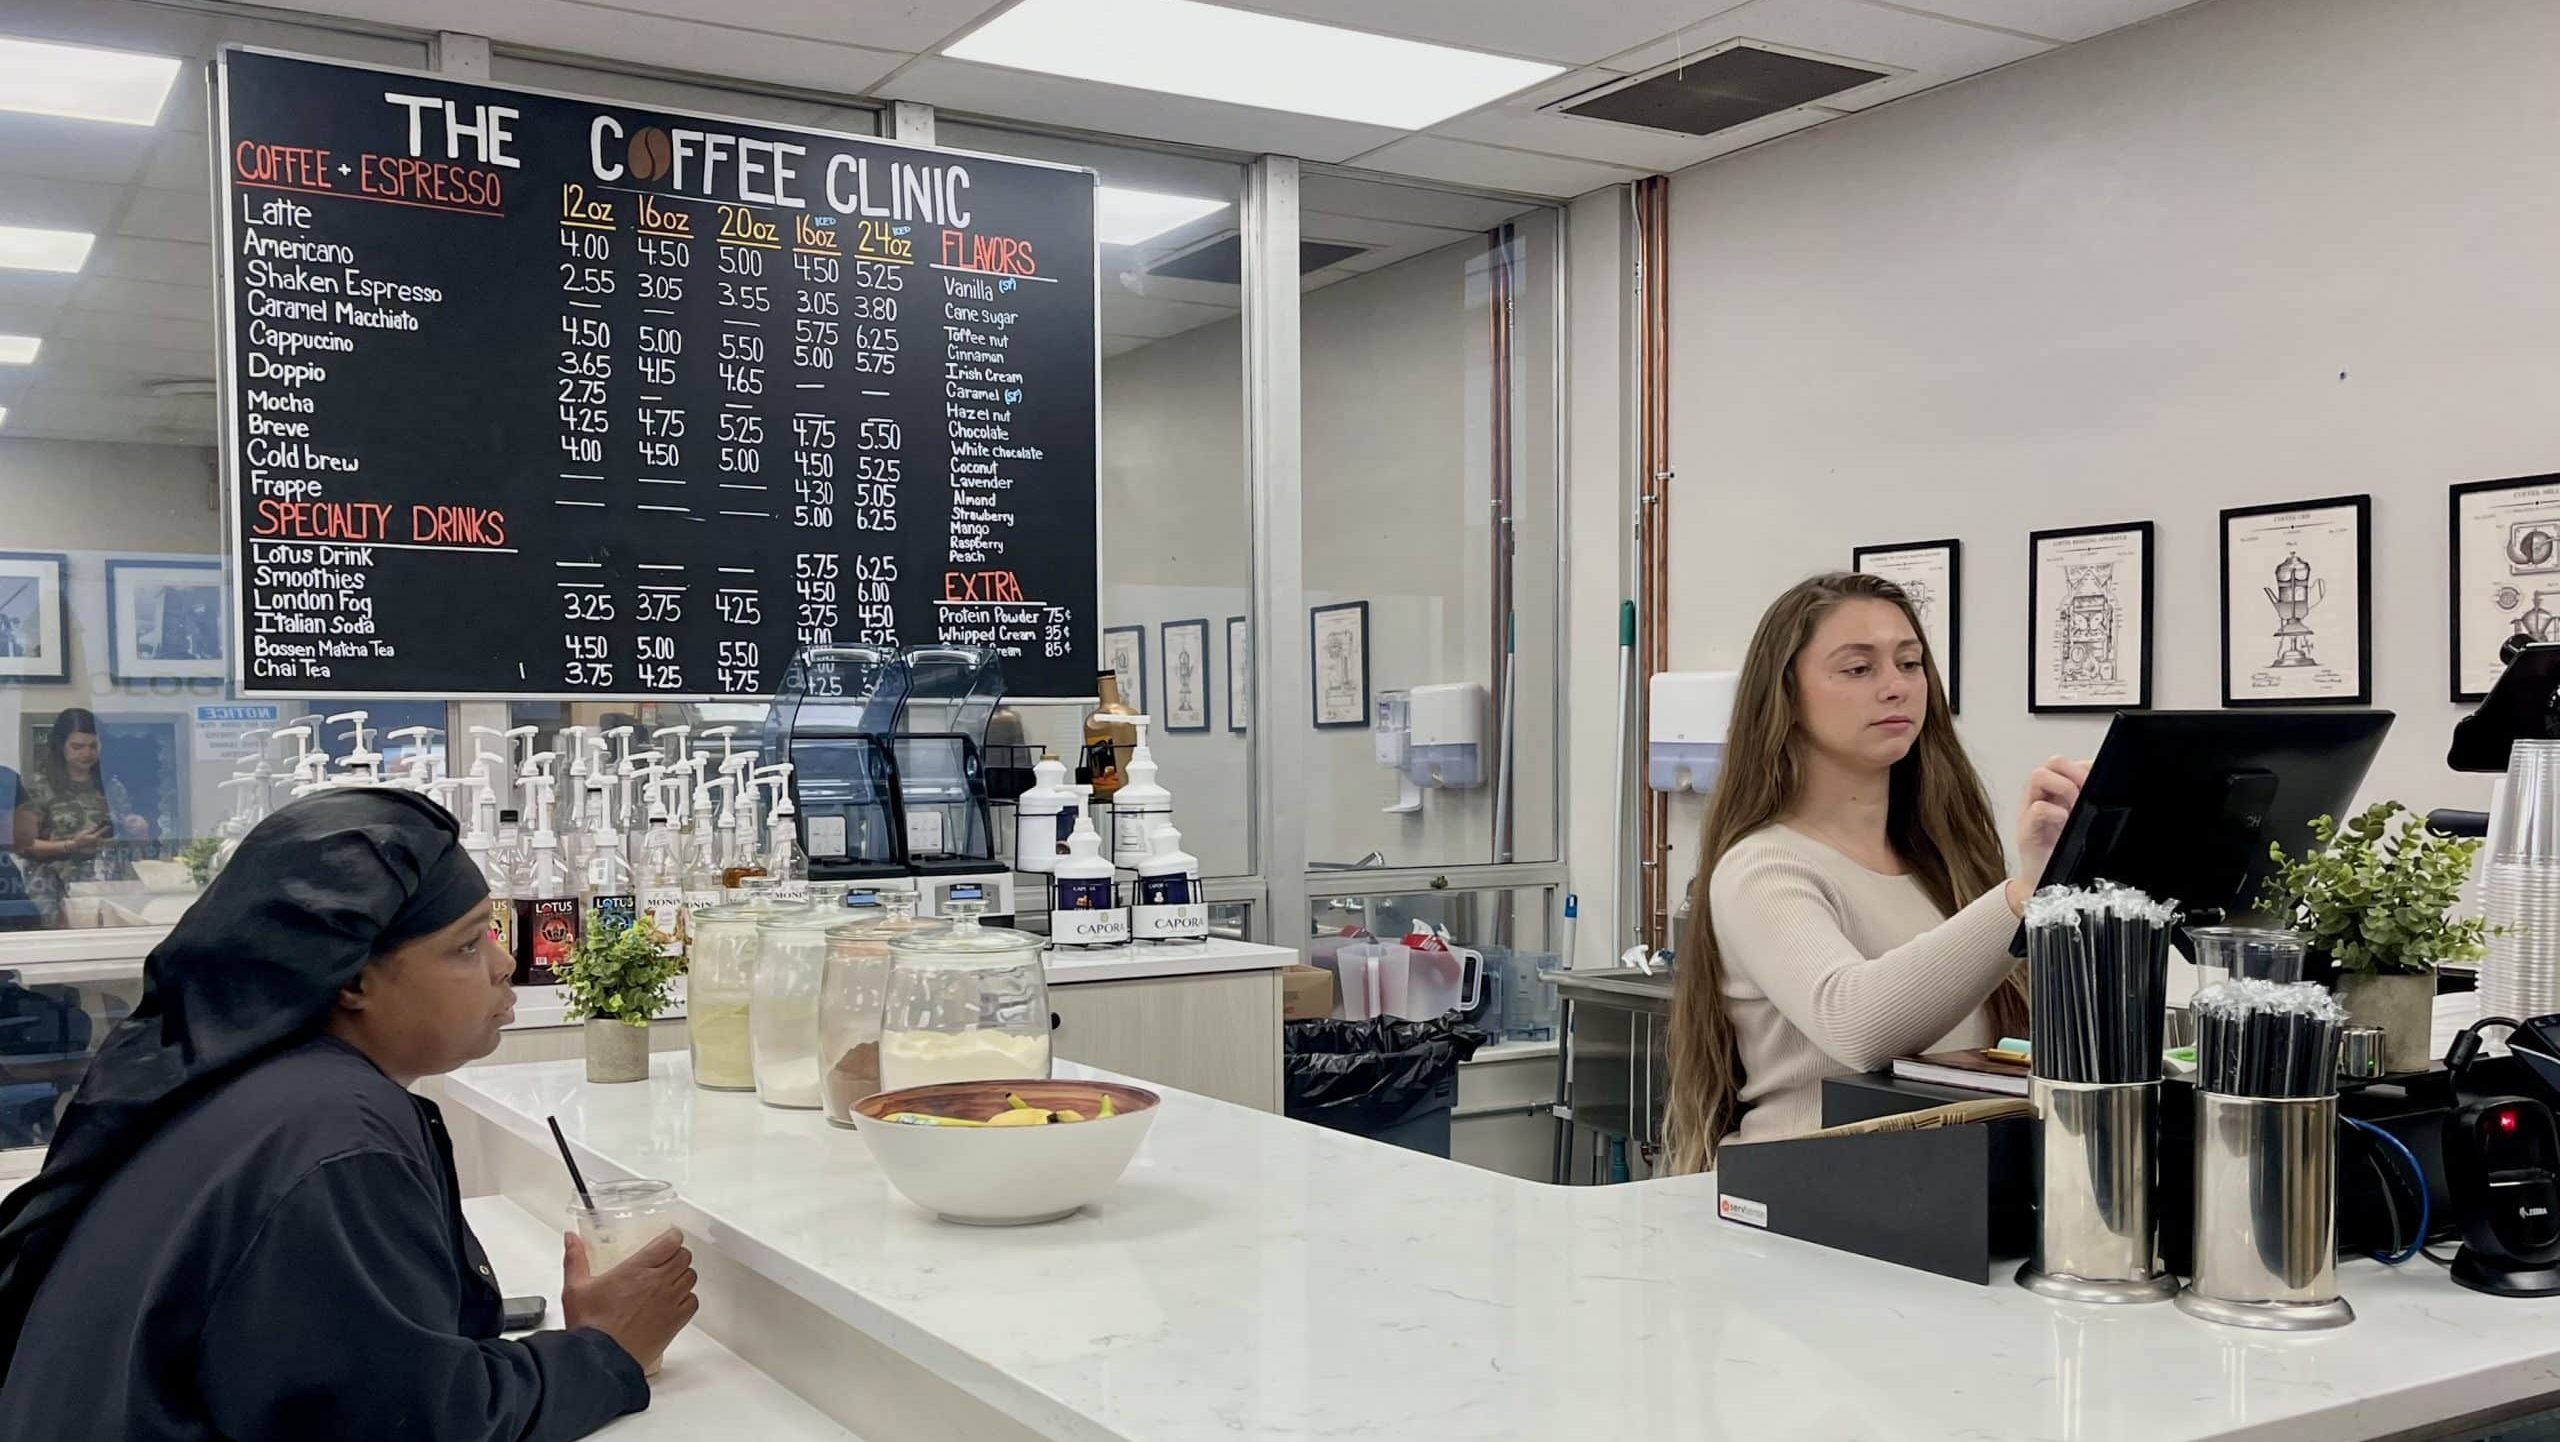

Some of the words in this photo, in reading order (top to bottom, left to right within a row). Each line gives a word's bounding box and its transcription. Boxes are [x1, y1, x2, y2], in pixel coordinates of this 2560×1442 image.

[235, 140, 332, 188] COFFEE
[361, 153, 500, 206] ESPRESSO
[385, 92, 521, 168] THE
[826, 153, 971, 228] CLINIC
[243, 194, 312, 228] Latte
[563, 183, 614, 222] 12oz
[639, 194, 690, 231] 16oz
[717, 205, 780, 241] 20oz
[795, 213, 838, 247] 16oz
[858, 220, 913, 257] 24oz
[243, 227, 353, 264] Americano
[942, 230, 1036, 275] FLAVORS
[560, 228, 610, 260] 4.00
[638, 237, 690, 267] 4.50
[718, 246, 762, 277] 5.00
[794, 253, 839, 283] 4.50
[855, 261, 904, 292] 5.25
[245, 260, 339, 293] Shaken
[345, 269, 442, 305] Espresso
[560, 263, 616, 294] 2.55
[638, 273, 684, 301] 3.05
[718, 282, 771, 312] 3.55
[796, 290, 839, 316] 3.05
[854, 296, 897, 322] 3.80
[944, 276, 993, 301] Vanilla
[247, 289, 327, 322] Caramel
[335, 300, 419, 331] Macchiato
[945, 302, 979, 322] Cane
[982, 311, 1019, 330] sugar
[249, 319, 354, 356] Cappuccino
[562, 315, 610, 348] 4.50
[638, 326, 682, 355] 5.00
[718, 334, 764, 363] 5.50
[795, 319, 839, 346] 5.75
[856, 325, 899, 351] 6.25
[944, 326, 985, 345] Toffee
[990, 335, 1009, 348] nut
[947, 344, 1004, 363] Cinnamon
[248, 352, 326, 388] Doppio
[557, 351, 612, 379] 3.65
[638, 356, 676, 385] 4.15
[719, 363, 765, 394] 4.65
[793, 345, 833, 369] 5.00
[855, 351, 896, 375] 5.75
[945, 363, 982, 381] Irish
[985, 368, 1023, 384] Cream
[248, 389, 314, 413] Mocha
[558, 379, 607, 404] 2.75
[946, 381, 999, 401] Caramel
[946, 402, 989, 420] Hazel
[993, 410, 1011, 422] nut
[248, 413, 310, 438] Breve
[560, 404, 609, 433] 4.25
[638, 407, 686, 437] 4.75
[717, 413, 764, 444] 5.25
[793, 418, 836, 448] 4.75
[857, 423, 901, 450] 5.50
[948, 420, 1009, 440] Chocolate
[247, 438, 299, 470] Cold
[305, 444, 359, 471] brew
[561, 435, 602, 462] 4.00
[638, 440, 679, 467] 4.50
[718, 447, 760, 473] 5.00
[794, 450, 833, 478] 4.50
[856, 456, 900, 482] 5.25
[951, 441, 990, 457] White
[992, 445, 1044, 460] chocolate
[950, 457, 998, 474] Coconut
[251, 470, 323, 502] Frappe
[795, 478, 834, 505] 4.30
[854, 484, 897, 508] 5.05
[950, 473, 1013, 489] Lavender
[953, 489, 996, 507] Almond
[252, 499, 393, 540] SPECIALTY
[412, 505, 505, 545] DRINKS
[793, 506, 833, 528] 5.00
[857, 509, 897, 531] 6.25
[950, 522, 989, 538] Mango
[951, 507, 1014, 527] Strawberry
[253, 544, 313, 564] Lotus
[320, 546, 374, 566] Drink
[949, 550, 985, 562] Peach
[950, 535, 1004, 554] Raspberry
[254, 565, 365, 590] Smoothies
[796, 554, 839, 579] 5.75
[856, 554, 898, 581] 6.25
[797, 580, 835, 601] 4.50
[858, 582, 890, 603] 6.00
[945, 571, 1024, 601] EXTRA
[253, 589, 334, 611] London
[339, 591, 372, 619] Fog
[564, 593, 615, 620] 3.25
[636, 593, 681, 622] 3.75
[716, 594, 761, 625] 4.25
[796, 604, 839, 627] 3.75
[858, 604, 894, 628] 4.50
[939, 606, 990, 624] Protein
[994, 606, 1039, 623] Powder
[254, 612, 326, 633] Italian
[329, 615, 375, 635] Soda
[938, 625, 995, 644] Whipped
[1000, 626, 1036, 641] Cream
[254, 635, 315, 658] Bossen
[319, 639, 368, 658] Matcha
[369, 640, 395, 658] Tea
[565, 634, 607, 659] 4.50
[636, 636, 674, 660] 5.00
[717, 642, 759, 667] 5.50
[253, 659, 297, 677] Chai
[301, 659, 331, 678] Tea
[565, 662, 613, 686] 3.75
[638, 663, 682, 689] 4.25
[718, 668, 760, 692] 4.75
